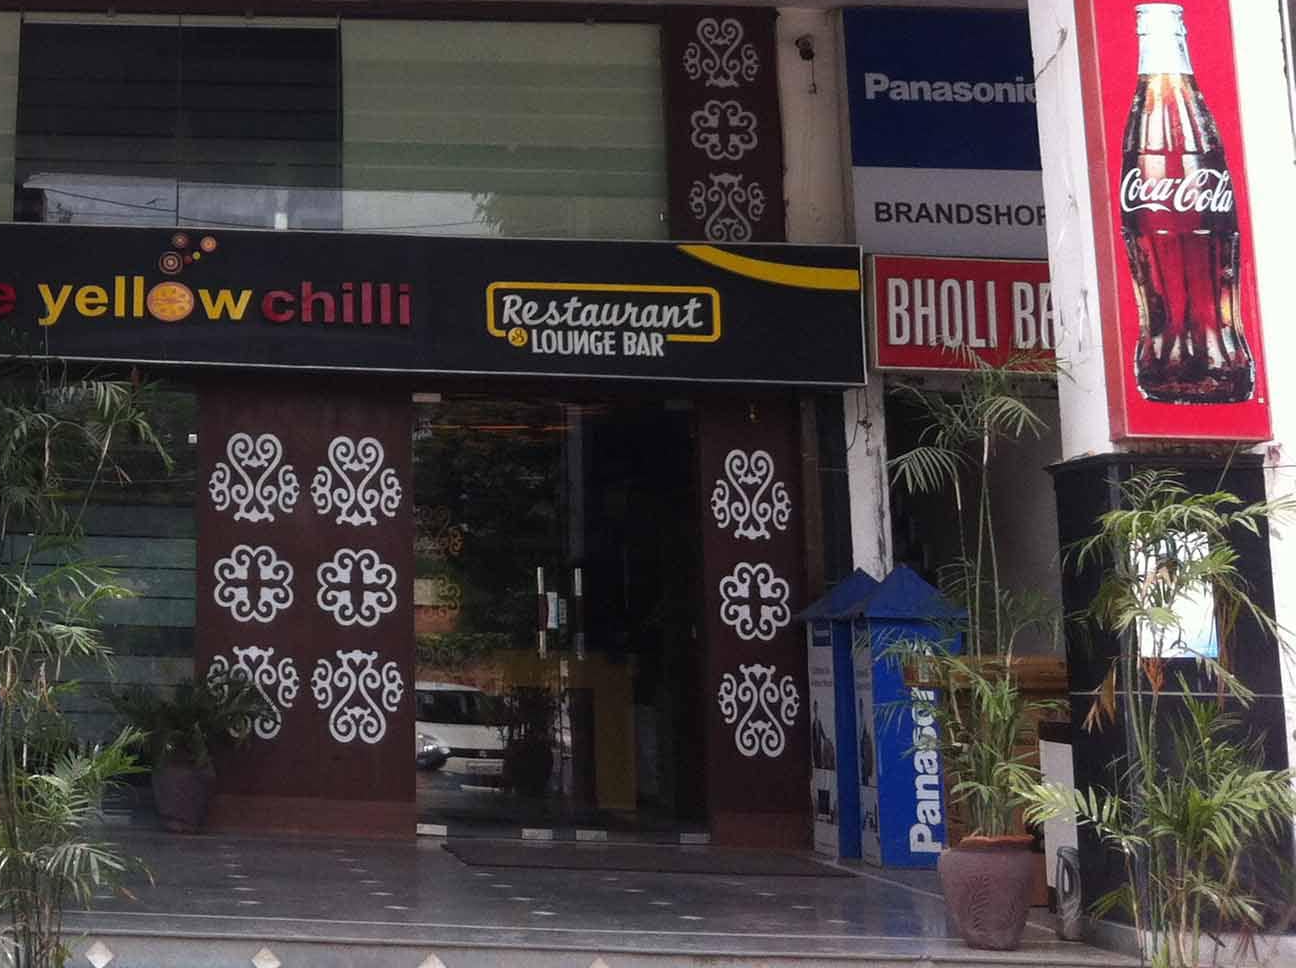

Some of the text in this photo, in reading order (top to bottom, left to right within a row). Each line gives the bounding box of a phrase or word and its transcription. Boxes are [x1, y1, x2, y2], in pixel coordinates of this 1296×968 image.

[1120, 168, 1234, 214] Coca-Cola
[37, 275, 253, 326] yellow
[262, 280, 412, 326] chilli
[502, 294, 704, 329] Restaurant
[887, 277, 998, 349] BHOLI
[531, 329, 616, 356] LOUNGE
[622, 331, 665, 357] BAR
